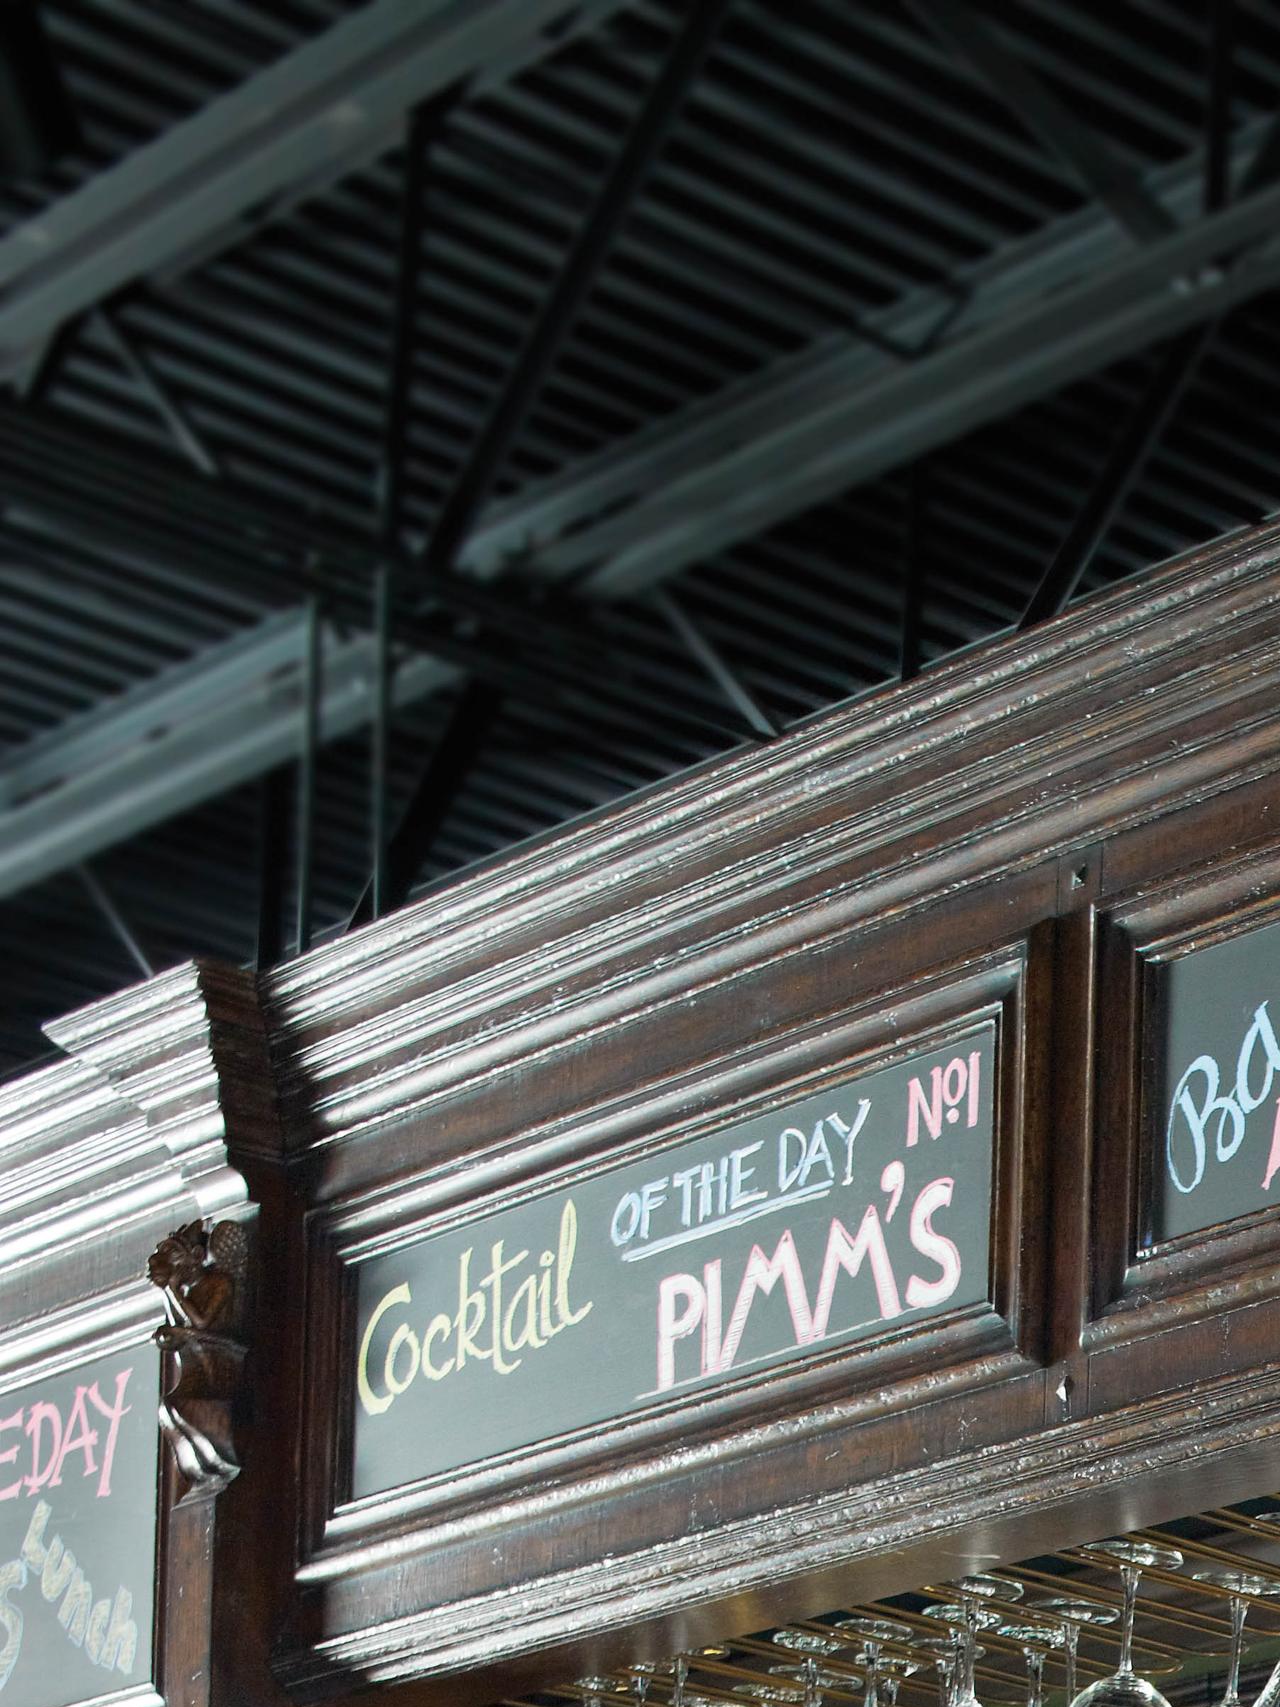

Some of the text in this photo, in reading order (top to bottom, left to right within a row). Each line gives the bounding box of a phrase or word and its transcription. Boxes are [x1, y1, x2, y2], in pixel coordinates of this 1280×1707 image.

[610, 1098, 872, 1247] OF THE DAY
[357, 1199, 593, 1414] Cocktail
[657, 1160, 963, 1393] PIMM'S
[22, 1500, 138, 1675] Lunch
